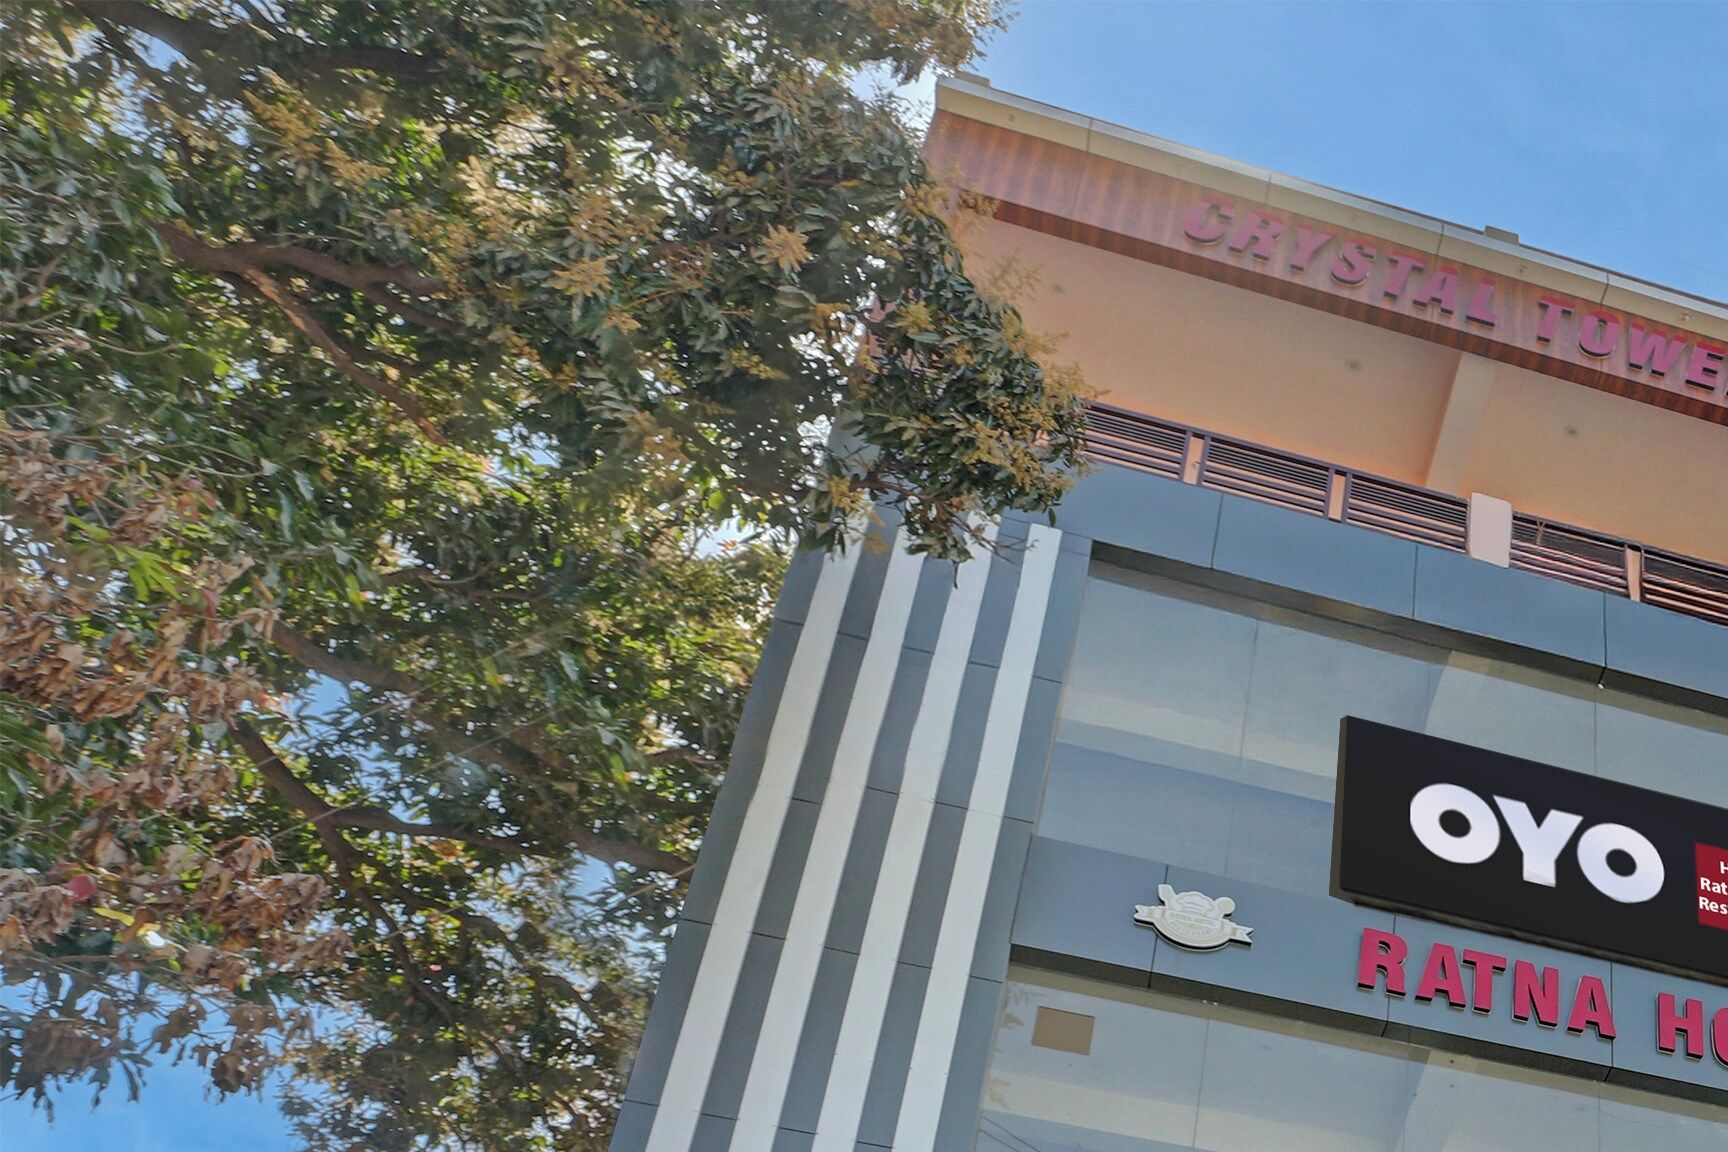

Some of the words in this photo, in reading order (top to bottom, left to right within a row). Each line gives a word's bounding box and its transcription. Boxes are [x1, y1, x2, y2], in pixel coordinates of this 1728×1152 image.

[1183, 198, 1499, 328] CRYSTAL
[1409, 782, 1665, 904] OYO
[1357, 927, 1616, 1042] RATNA
